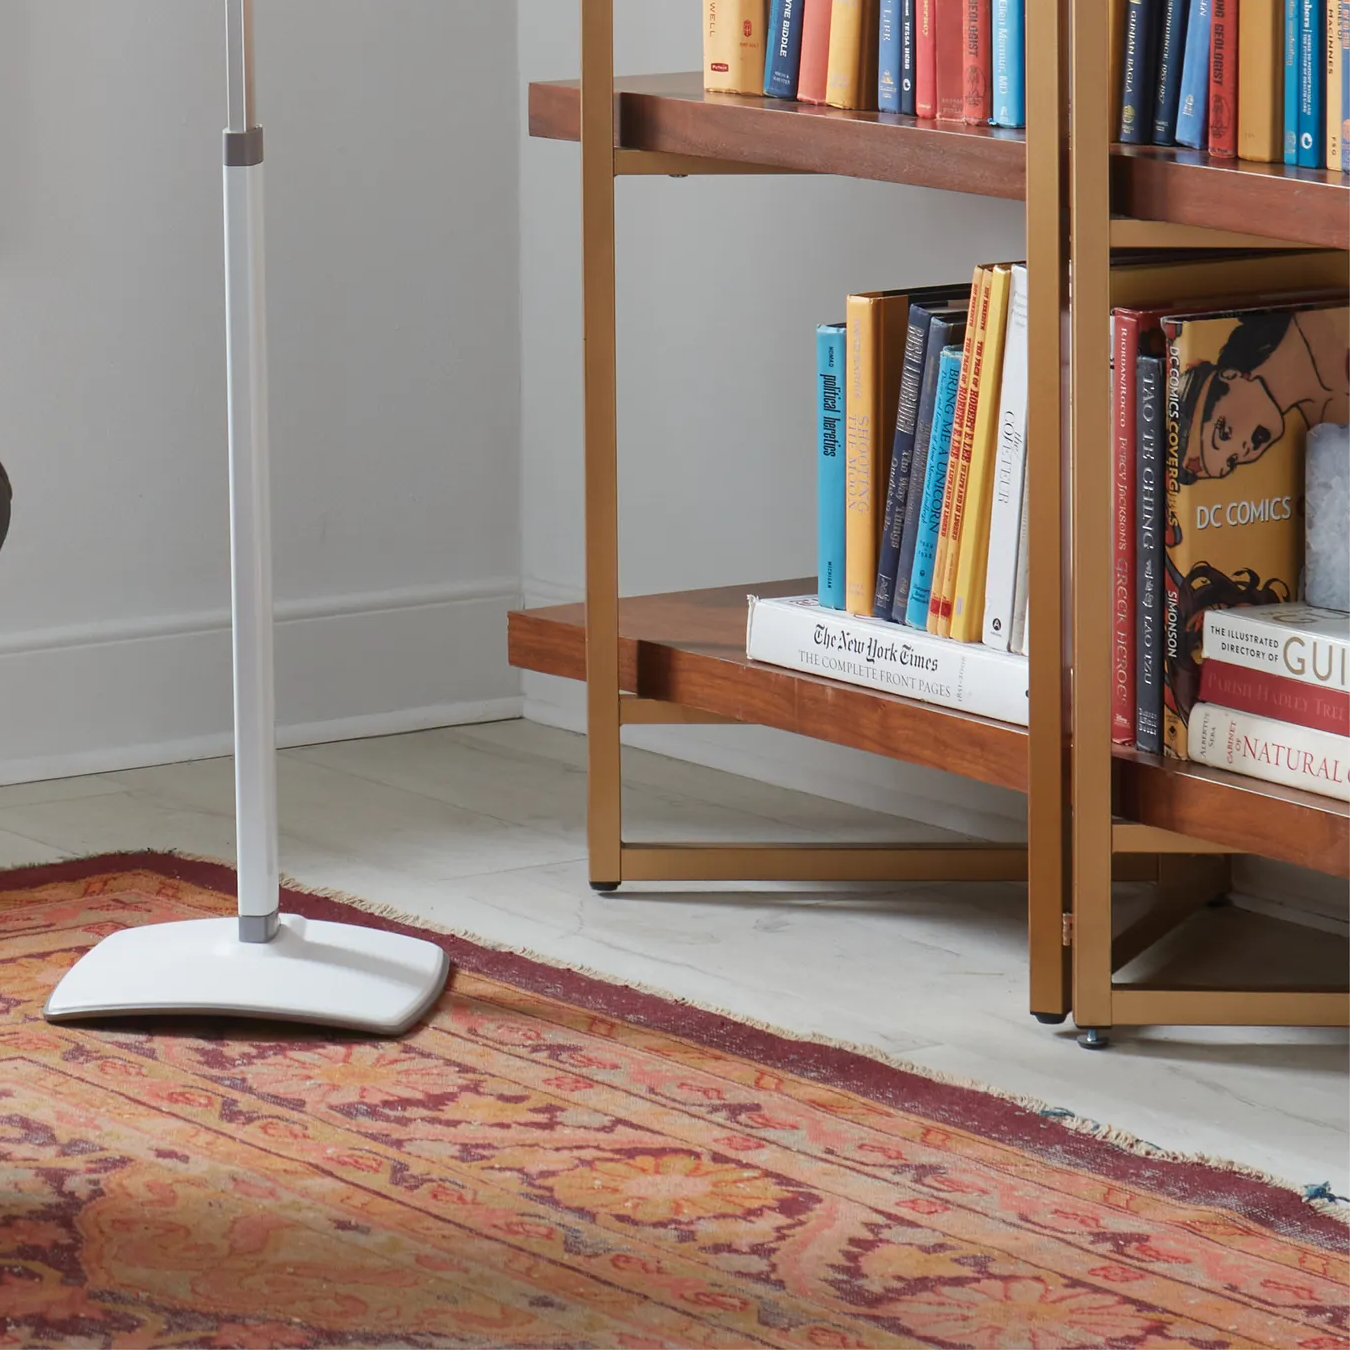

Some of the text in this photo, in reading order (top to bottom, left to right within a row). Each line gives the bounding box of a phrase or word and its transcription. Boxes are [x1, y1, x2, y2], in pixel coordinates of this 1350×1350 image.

[779, 20, 791, 58] BIDDLE
[882, 9, 893, 43] LIFE
[1125, 10, 1137, 93] GUNJAN BAGLA
[1213, 23, 1226, 86] GEOLOGIST
[997, 75, 1007, 94] MD
[1119, 327, 1128, 428] RIORDAN/ROCCO
[1142, 373, 1155, 423] TAO
[820, 373, 841, 457] political heretics
[930, 397, 944, 444] and of
[1166, 346, 1180, 528] DC COMICS COVERGIRLS
[847, 414, 858, 510] THE MOON
[857, 414, 870, 515] SHOOTING
[929, 368, 959, 534] BRING ME A UNICORN
[940, 374, 968, 538] OF ROBERT E. LEE LIFE AND LEGEND
[951, 341, 984, 541] THE OF ROBERT E. LEE LIFE AND LEGEND
[1118, 436, 1128, 479] PERCY
[1142, 428, 1155, 461] TE
[890, 449, 912, 549] The Way Things
[1116, 482, 1128, 550] JACKSON'S
[1141, 467, 1156, 551] CHING
[1196, 496, 1292, 530] DC COMICS
[1115, 557, 1128, 626] GREEK
[813, 623, 939, 672] The New York Times
[1143, 614, 1153, 647] LAO
[1166, 590, 1178, 658] SIMONSON
[1210, 625, 1279, 649] THE ILLUSTRATED
[798, 649, 951, 699] THE COMPLETE FRONT PAGES
[1115, 630, 1128, 709] HEROES
[1143, 651, 1153, 686] TZU
[1221, 642, 1279, 663] DIRECTORY OF
[1282, 636, 1346, 686] GUI
[1207, 672, 1310, 714] PARISH HADLEY
[1200, 712, 1210, 758] ALBERTUS
[1208, 726, 1216, 748] SEBA
[1226, 721, 1237, 764] CABINET
[1235, 737, 1242, 752] OF
[1242, 735, 1343, 784] NATURAL
